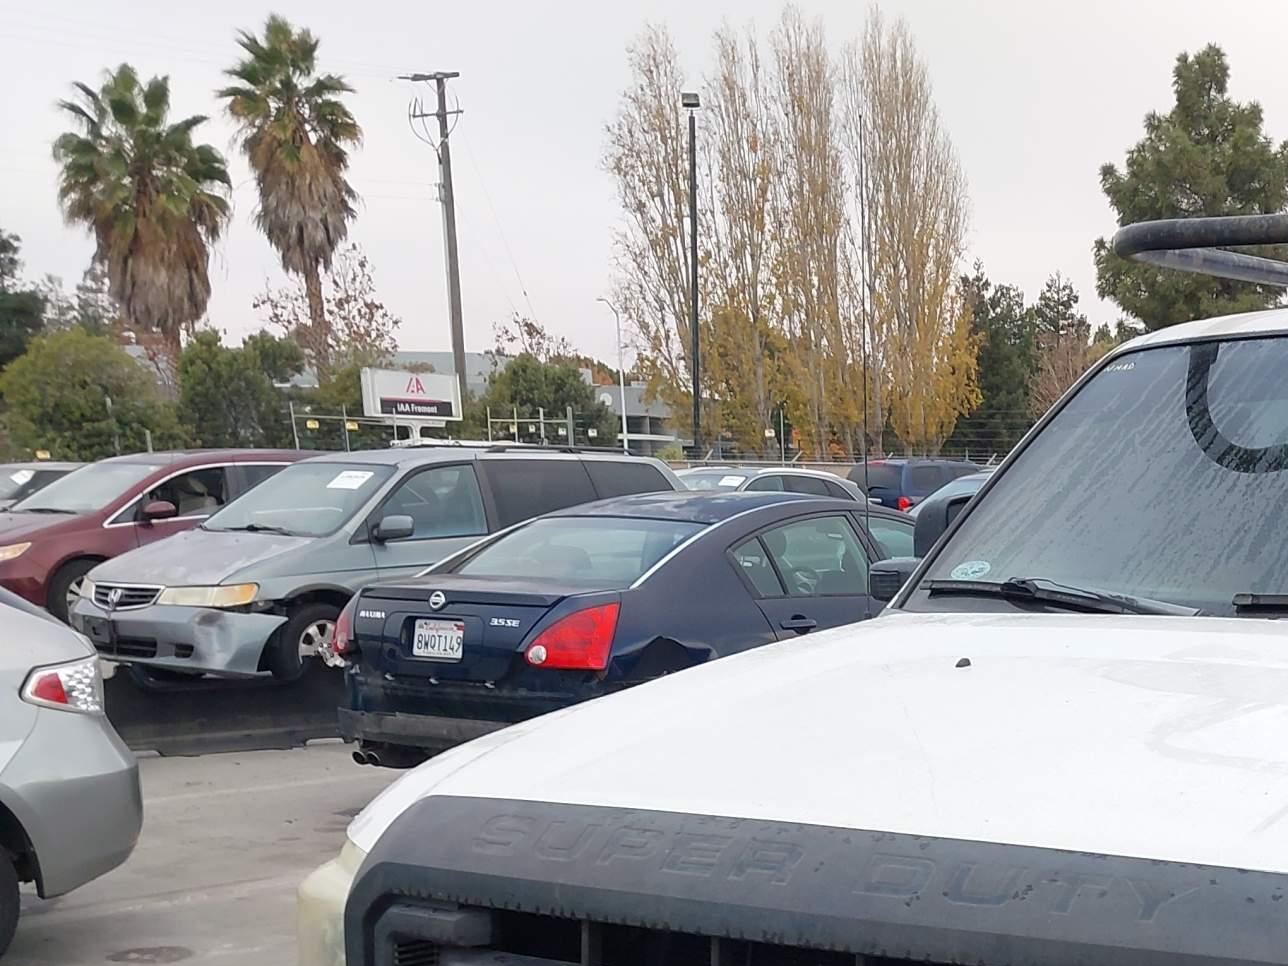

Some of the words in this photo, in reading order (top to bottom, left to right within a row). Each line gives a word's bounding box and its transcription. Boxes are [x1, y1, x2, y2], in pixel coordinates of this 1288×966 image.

[397, 402, 411, 413] IAA
[411, 404, 438, 415] Fremont
[416, 633, 462, 655] 8WQT149
[472, 814, 804, 887] SUPER
[852, 852, 1204, 925] DUTY
